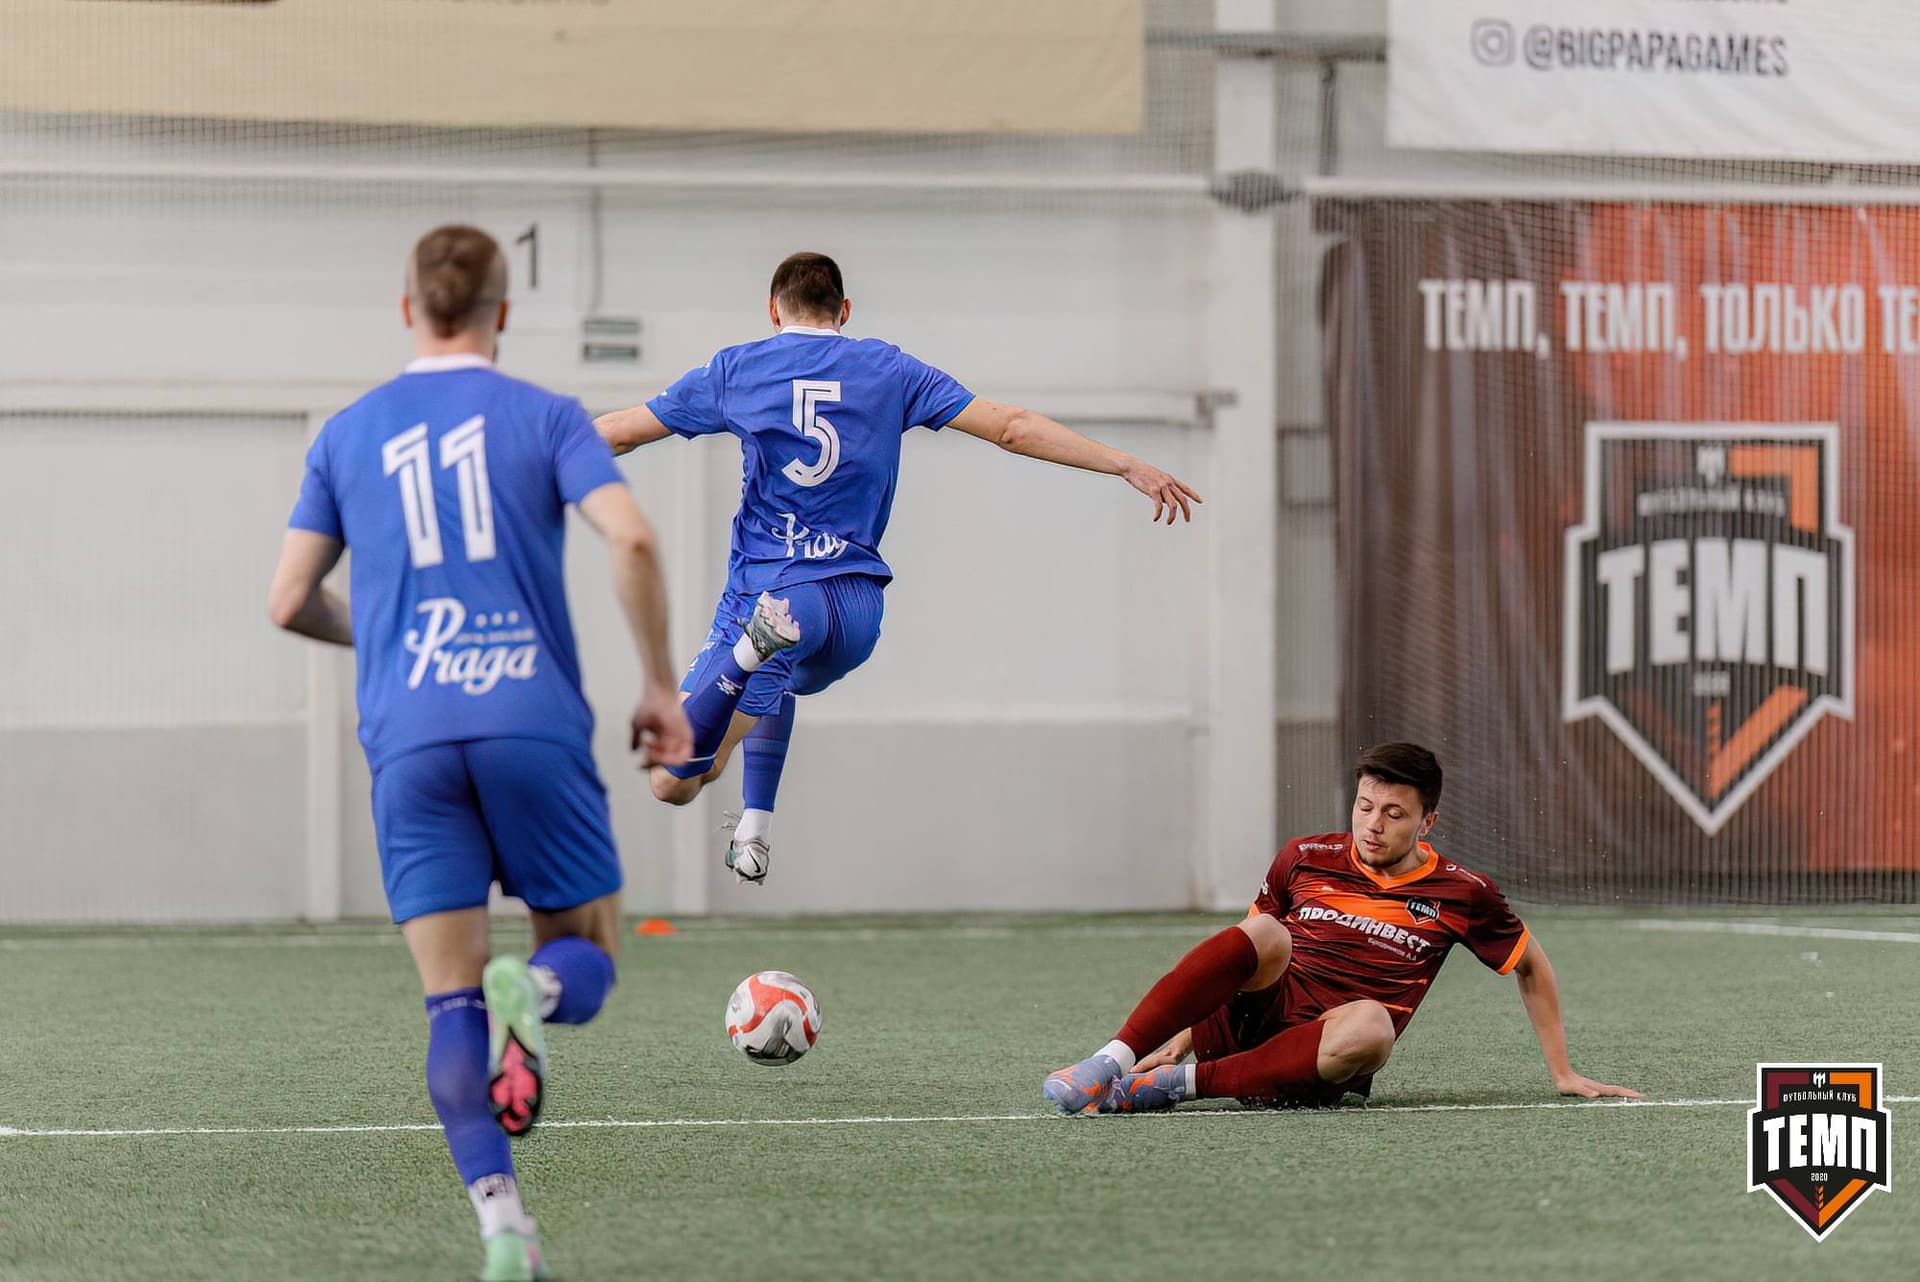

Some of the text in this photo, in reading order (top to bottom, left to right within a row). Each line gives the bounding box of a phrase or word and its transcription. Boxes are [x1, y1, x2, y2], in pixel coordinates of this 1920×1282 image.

[1523, 26, 1789, 77] @BIGPAPAGAMES
[515, 223, 538, 289] 1
[1419, 279, 1549, 360] ТЕМП,
[1560, 281, 1687, 362] ТЕМП,
[1700, 283, 1866, 354] ТОЛЬКО
[782, 379, 841, 487] 5
[382, 414, 497, 569] 11
[404, 598, 538, 696] Praga
[1598, 537, 1828, 676] ТЕМП
[1299, 907, 1431, 953] ПРОДИНВЕСТ
